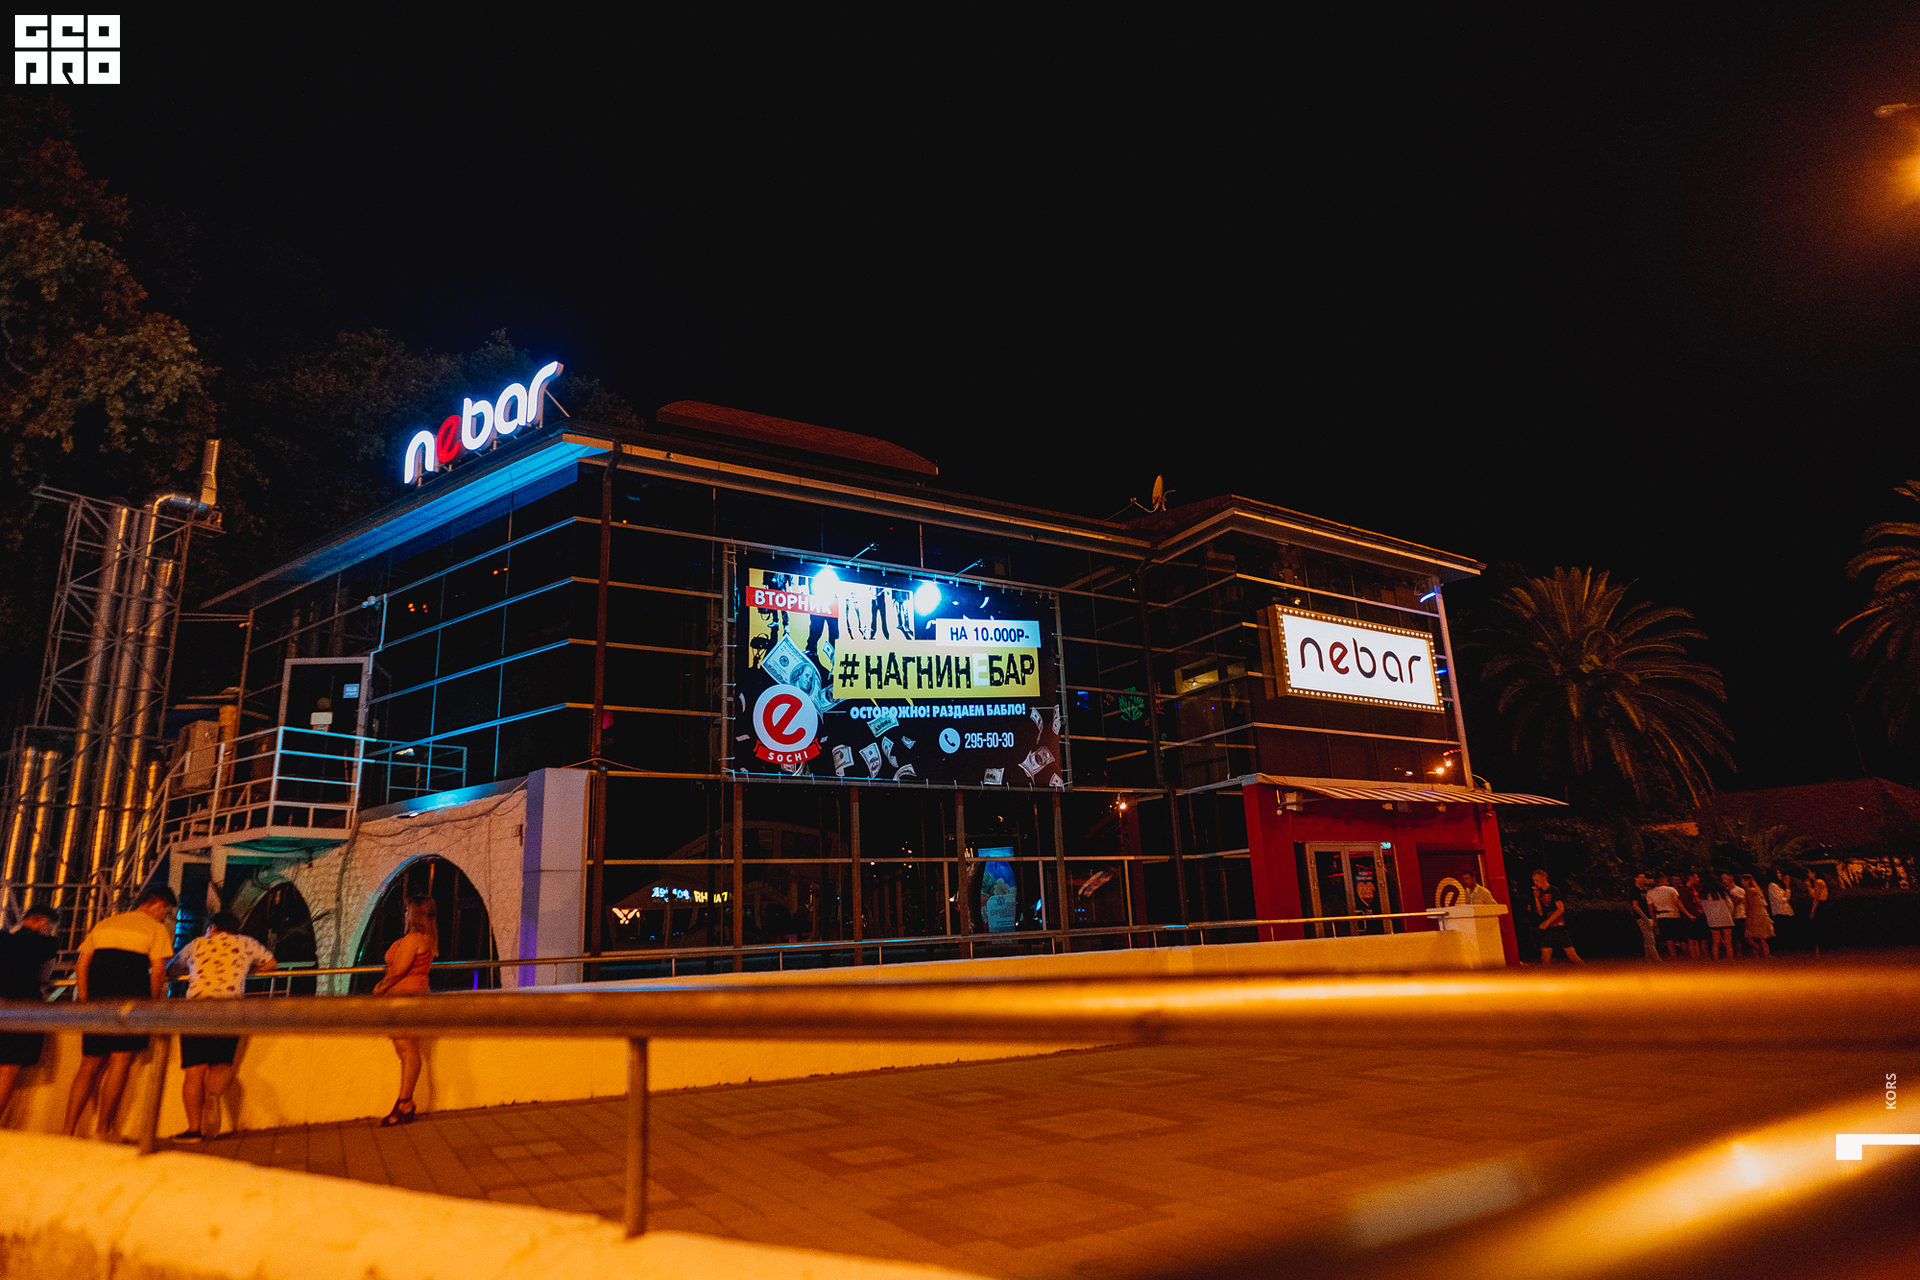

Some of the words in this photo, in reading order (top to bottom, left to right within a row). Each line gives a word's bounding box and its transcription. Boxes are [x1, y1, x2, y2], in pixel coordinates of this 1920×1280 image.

[404, 361, 562, 484] nebar
[754, 590, 832, 615] ВТОРНИК
[950, 625, 968, 641] НА
[839, 652, 1035, 690] #НАГНИНЕБАР
[1299, 637, 1421, 684] nebar
[850, 705, 930, 719] ОСТОРОЖНО!
[933, 705, 984, 719] РАЗДАЕМ
[986, 703, 1026, 716] БАБЛО!
[964, 731, 1015, 749] 295-50-30
[768, 751, 808, 763] SOCHI
